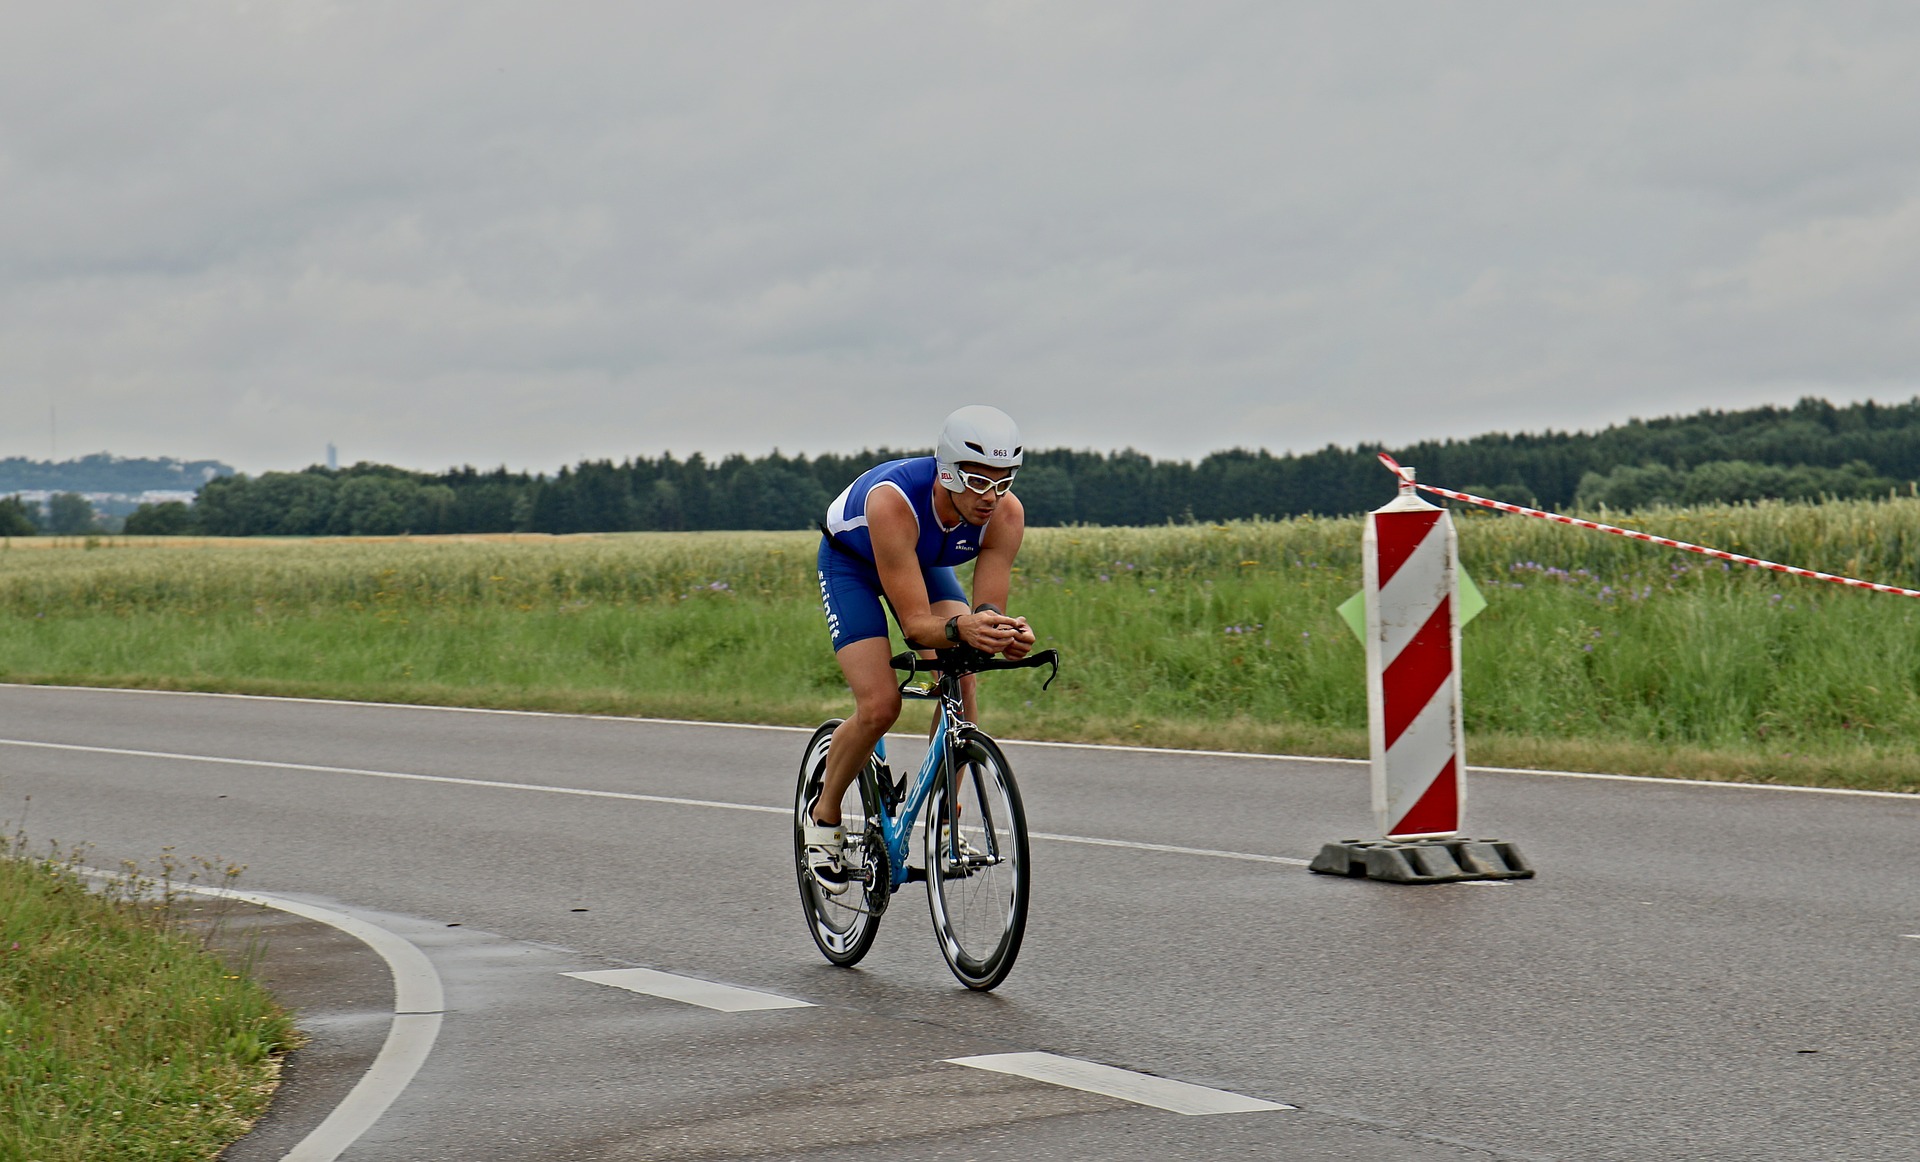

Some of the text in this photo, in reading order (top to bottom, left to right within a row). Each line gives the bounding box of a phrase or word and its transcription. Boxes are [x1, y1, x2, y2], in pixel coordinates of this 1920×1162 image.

[993, 449, 1008, 457] 863
[941, 472, 953, 480] BELL
[817, 570, 840, 642] skinfit
